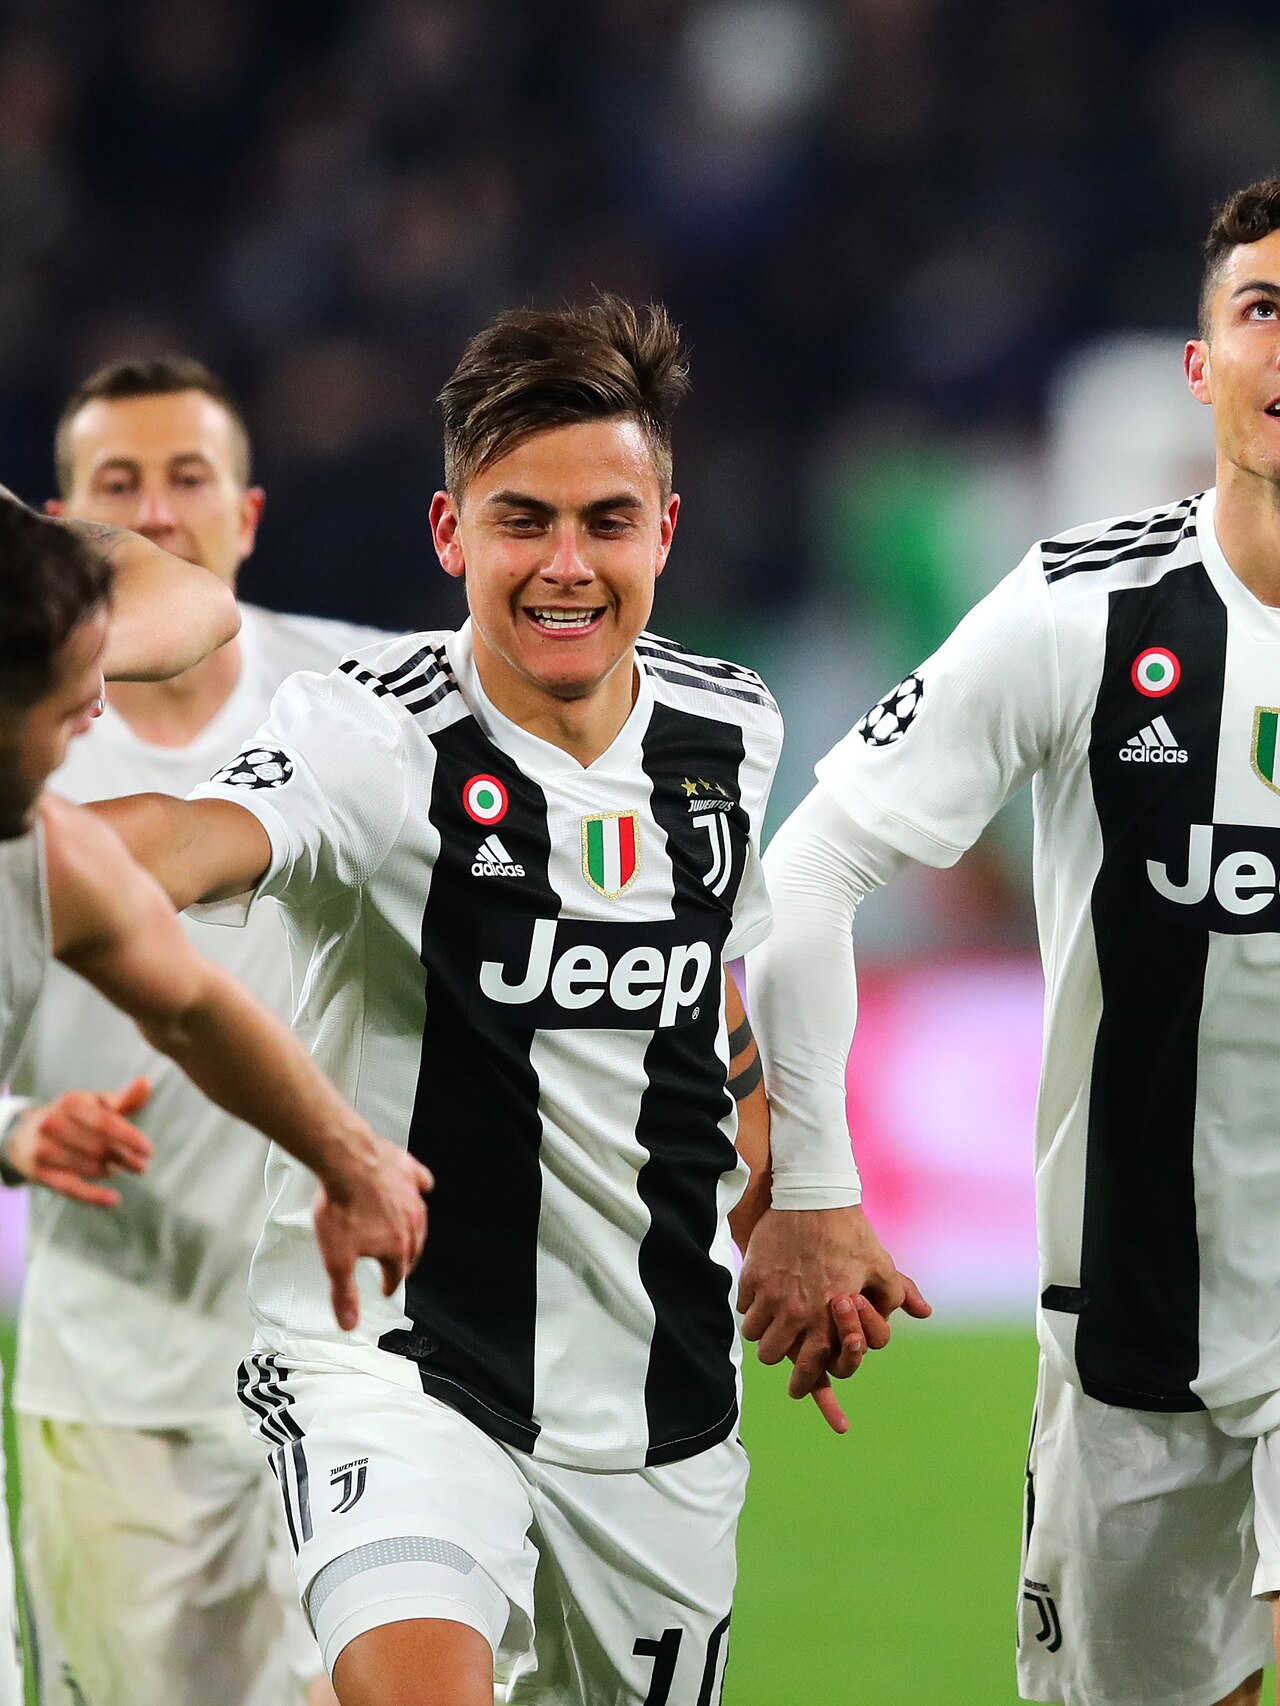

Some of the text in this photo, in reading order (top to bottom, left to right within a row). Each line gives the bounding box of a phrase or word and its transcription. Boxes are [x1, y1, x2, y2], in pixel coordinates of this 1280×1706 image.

[1118, 744, 1189, 764] adidas
[687, 799, 735, 813] JUVENTUS
[471, 861, 526, 877] adidas
[480, 919, 711, 1027] Jeep
[329, 1457, 369, 1477] JUVENTUS
